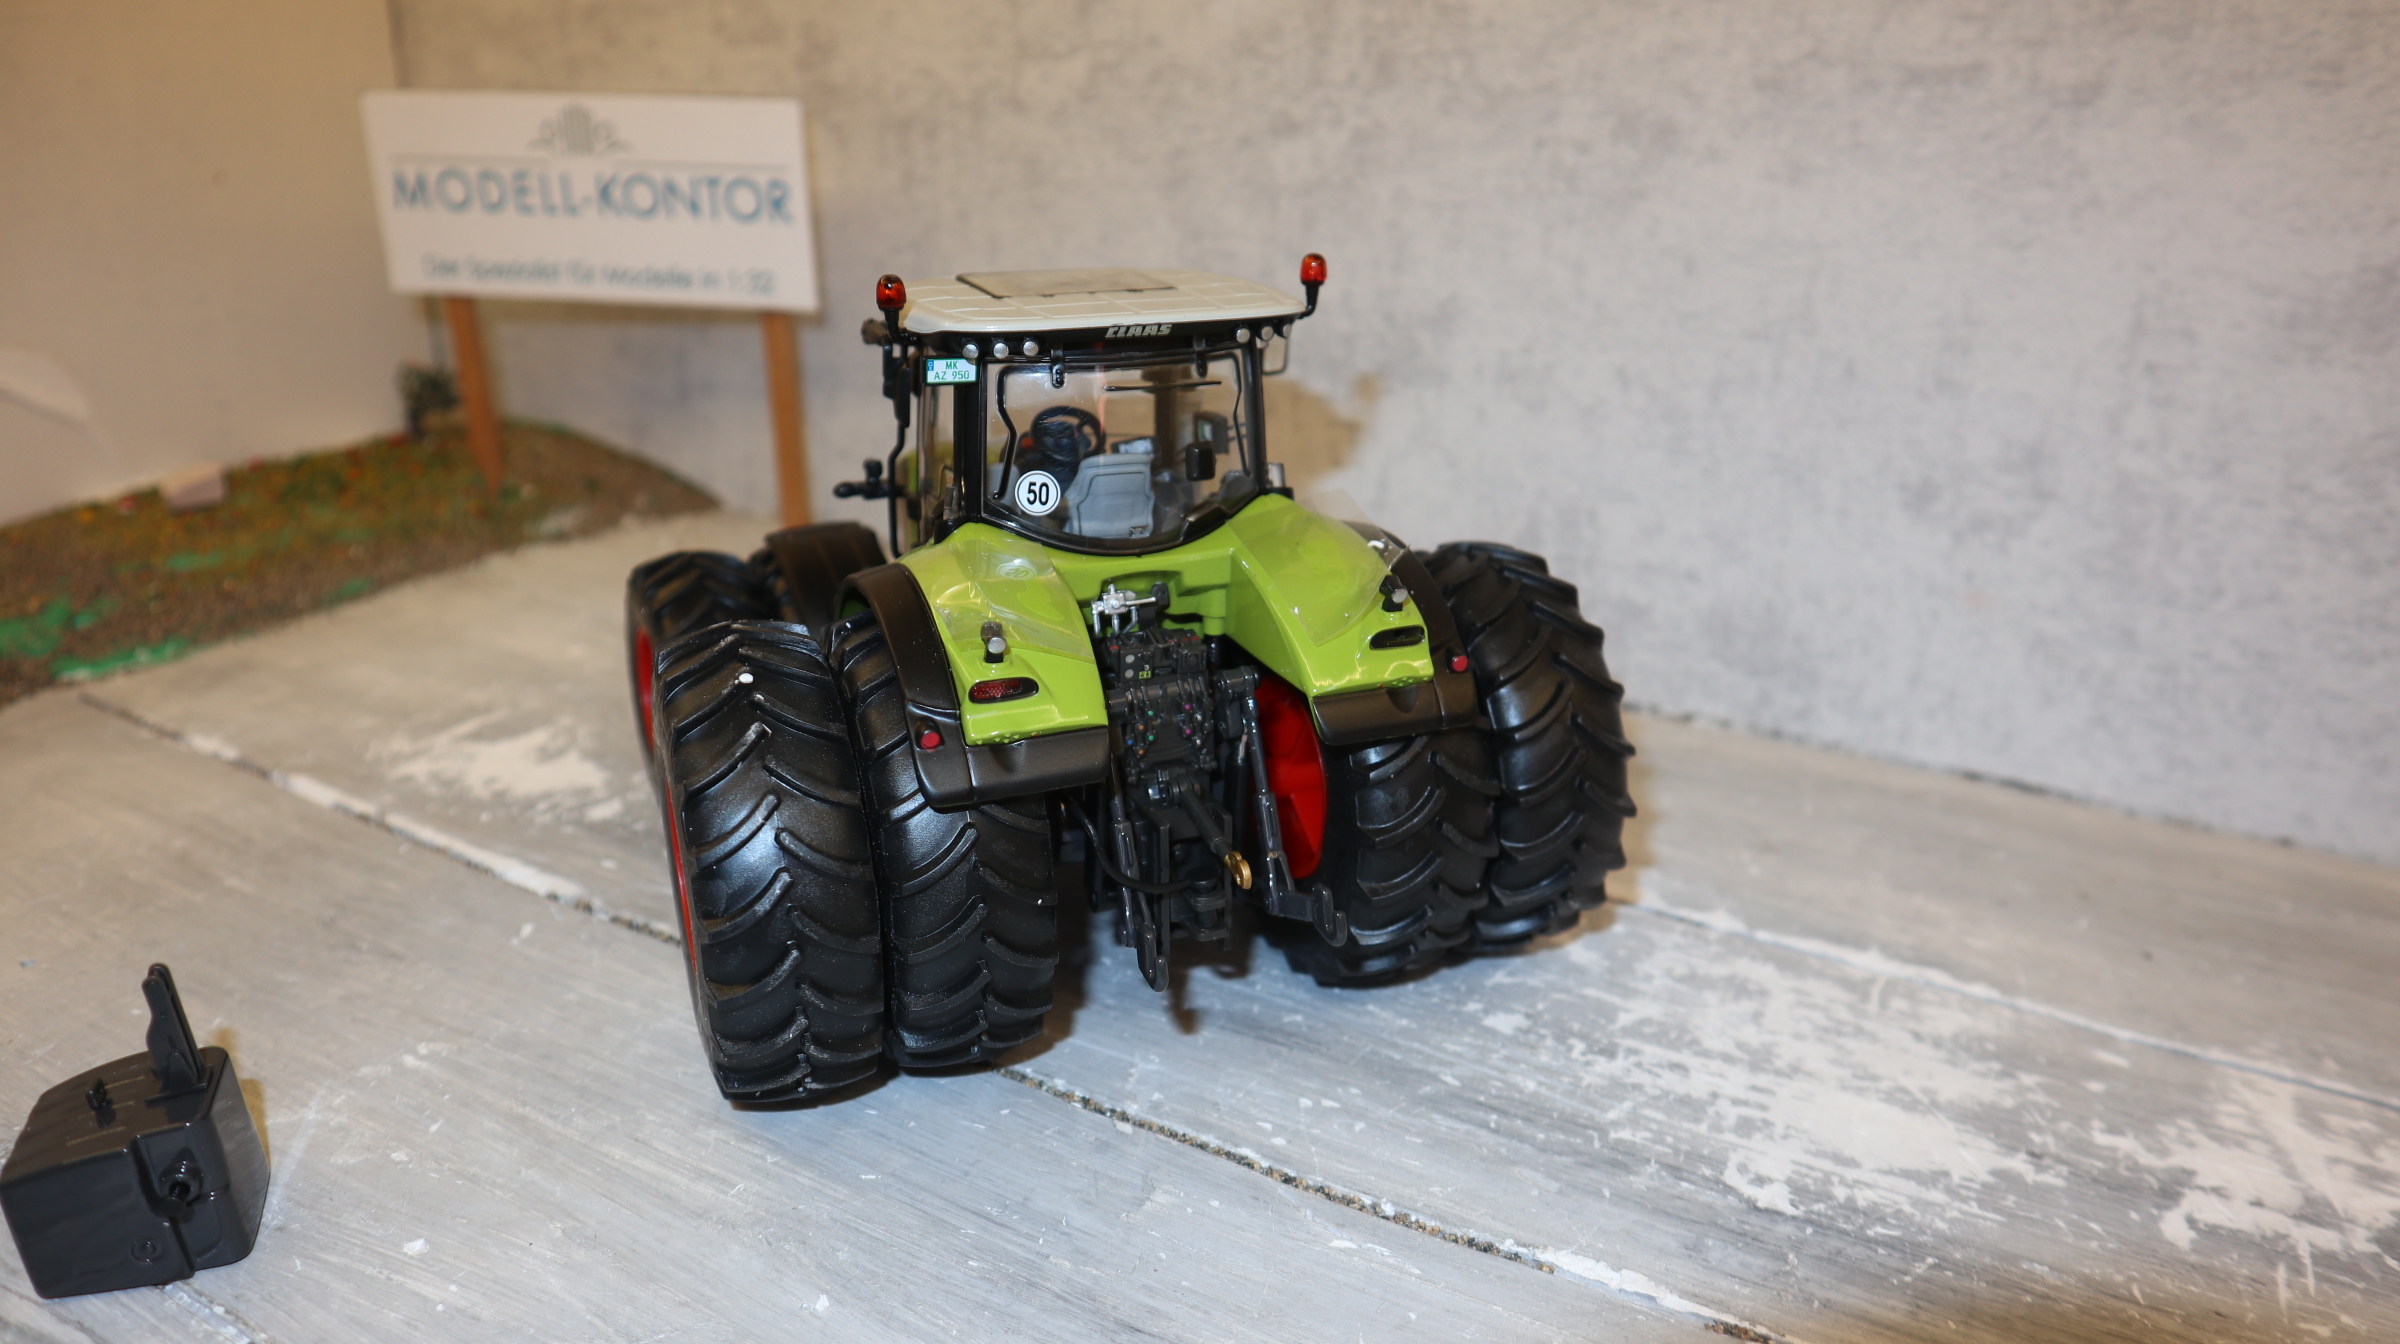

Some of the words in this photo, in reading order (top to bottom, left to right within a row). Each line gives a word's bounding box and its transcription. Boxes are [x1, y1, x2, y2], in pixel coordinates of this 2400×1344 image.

[393, 167, 793, 223] MODELL-KONTOR
[1105, 324, 1172, 338] CLAAS
[945, 360, 958, 370] MK
[934, 371, 947, 380] AZ
[952, 370, 970, 380] 950
[1027, 481, 1049, 506] 50
